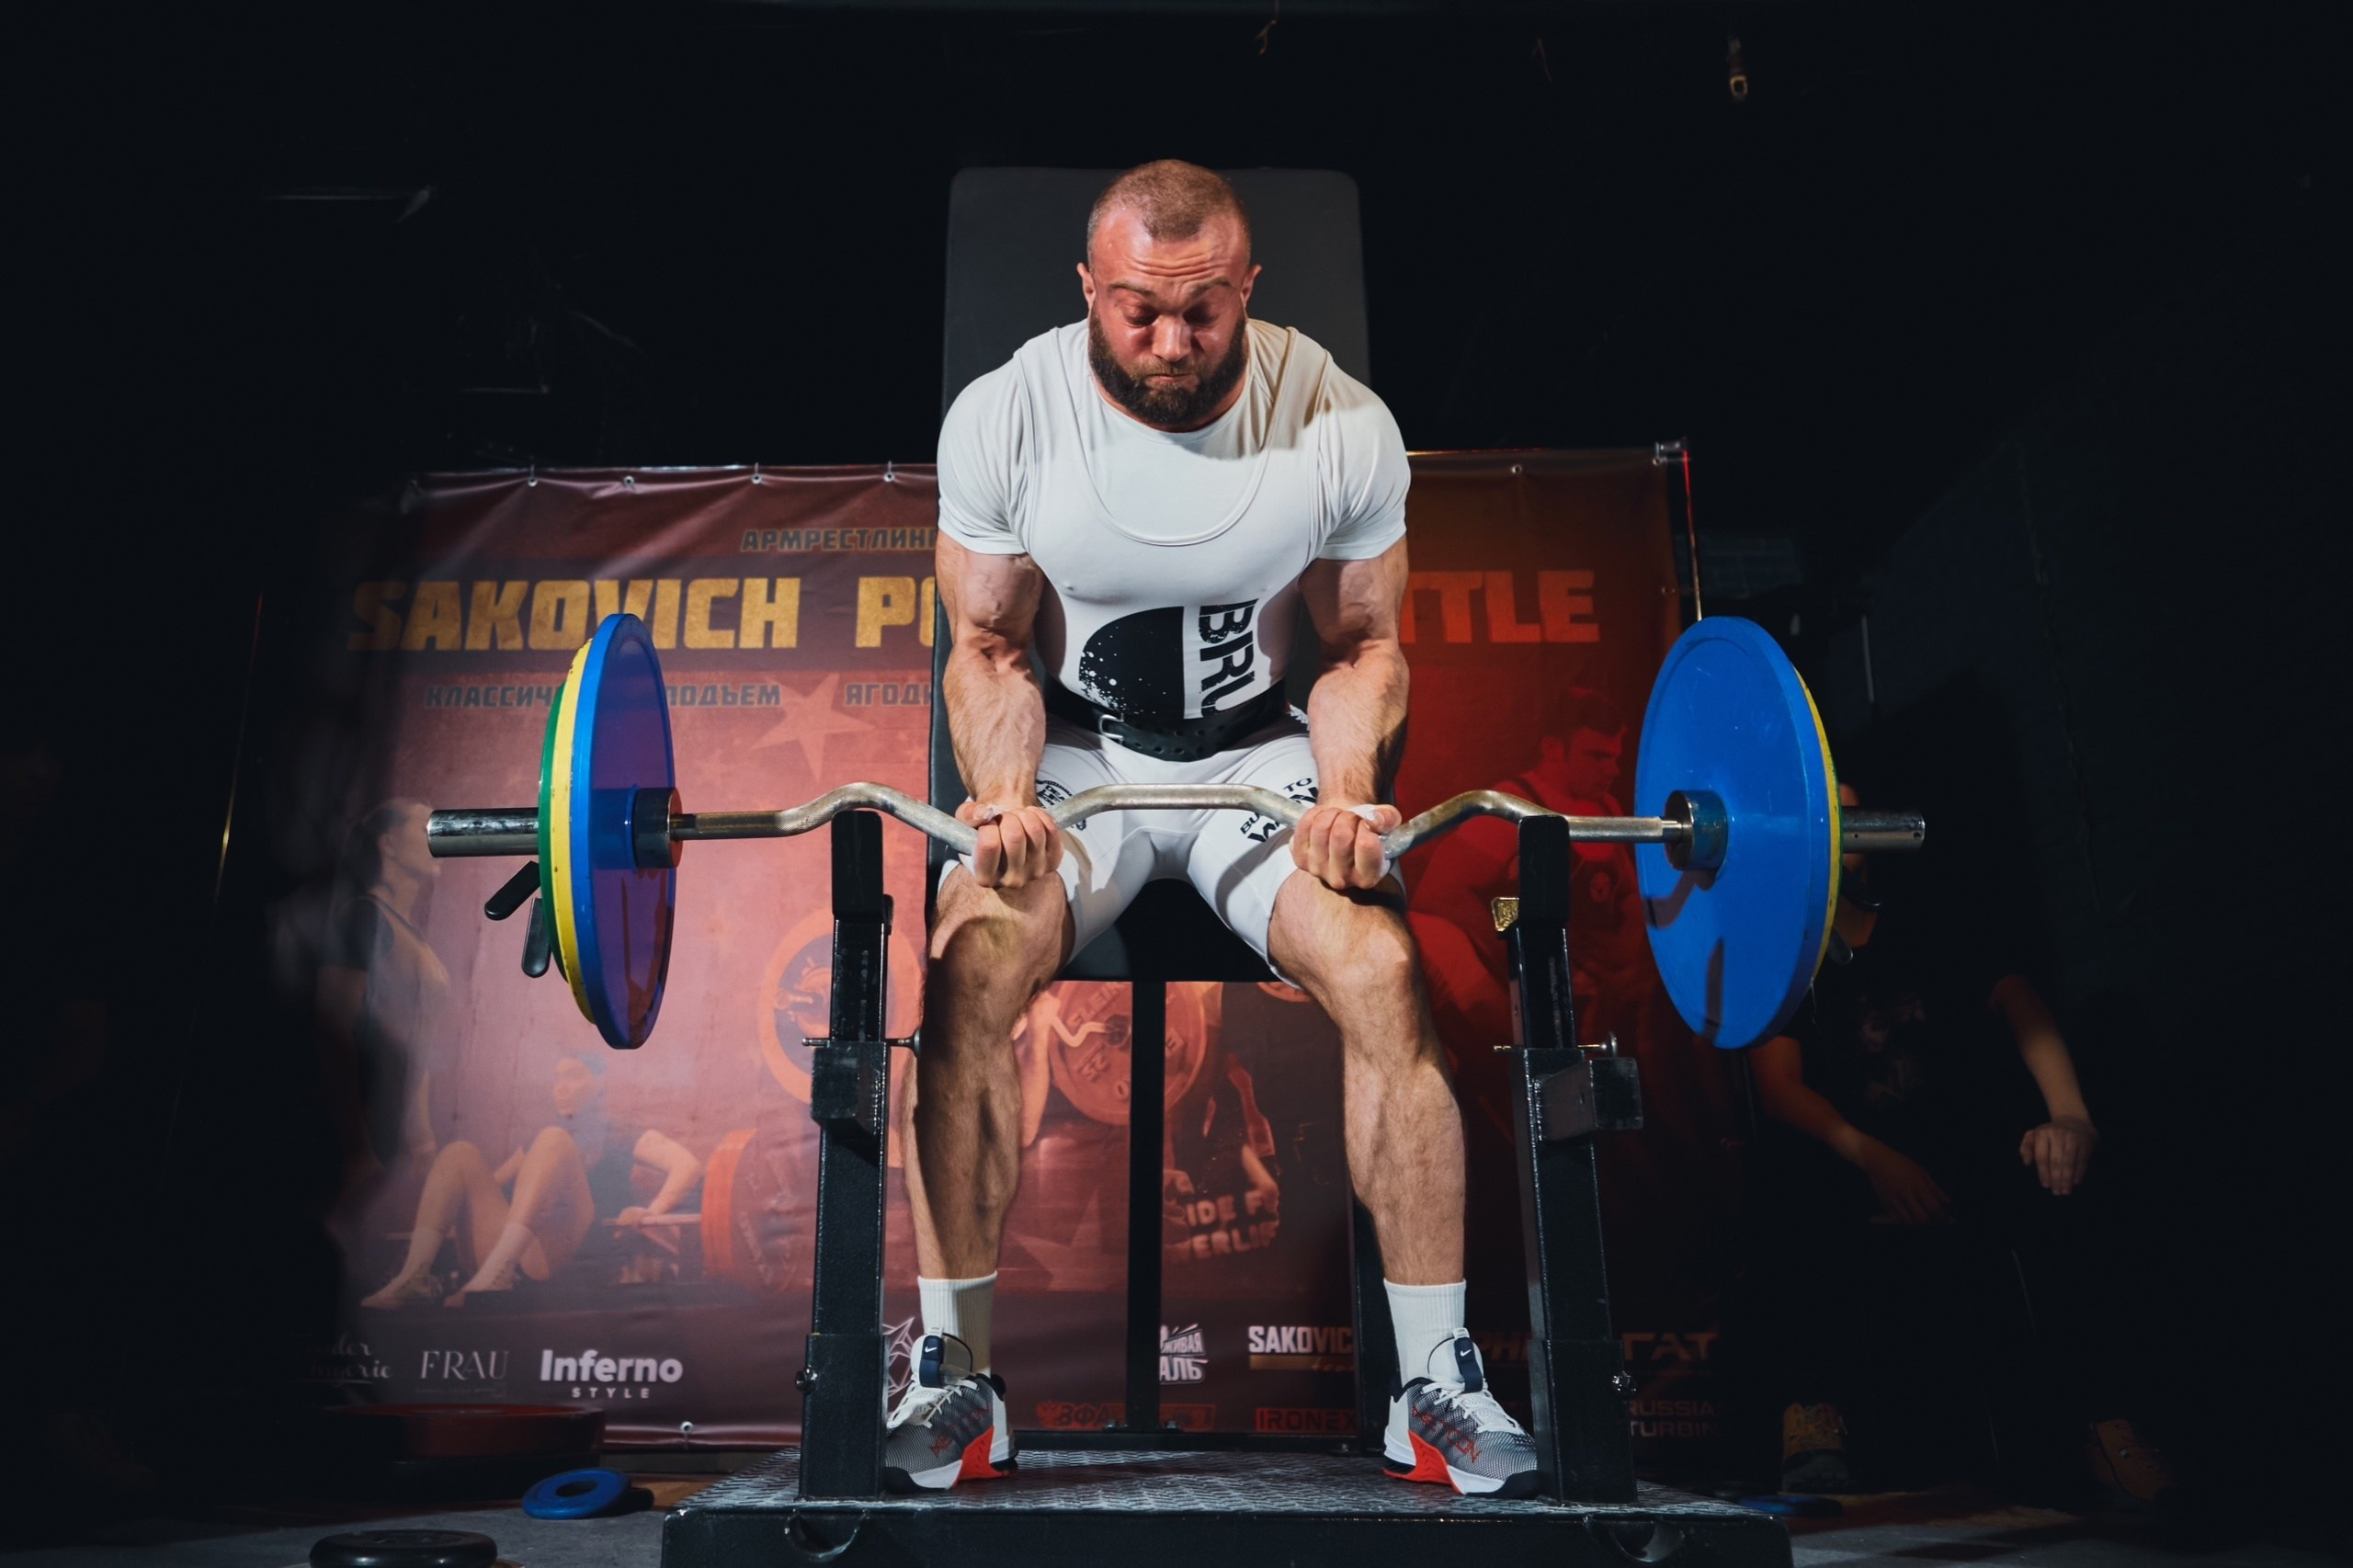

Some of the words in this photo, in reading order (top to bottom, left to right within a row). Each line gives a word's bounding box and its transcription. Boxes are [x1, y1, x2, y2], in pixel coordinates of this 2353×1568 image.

[346, 578, 801, 650] SAKOVICH
[855, 576, 936, 647] P
[1283, 778, 1313, 792] TO
[1248, 1325, 1354, 1354] SAKOVIC
[421, 1350, 509, 1381] FRAU
[540, 1348, 684, 1383] Inferno
[572, 1387, 650, 1399] STYLE
